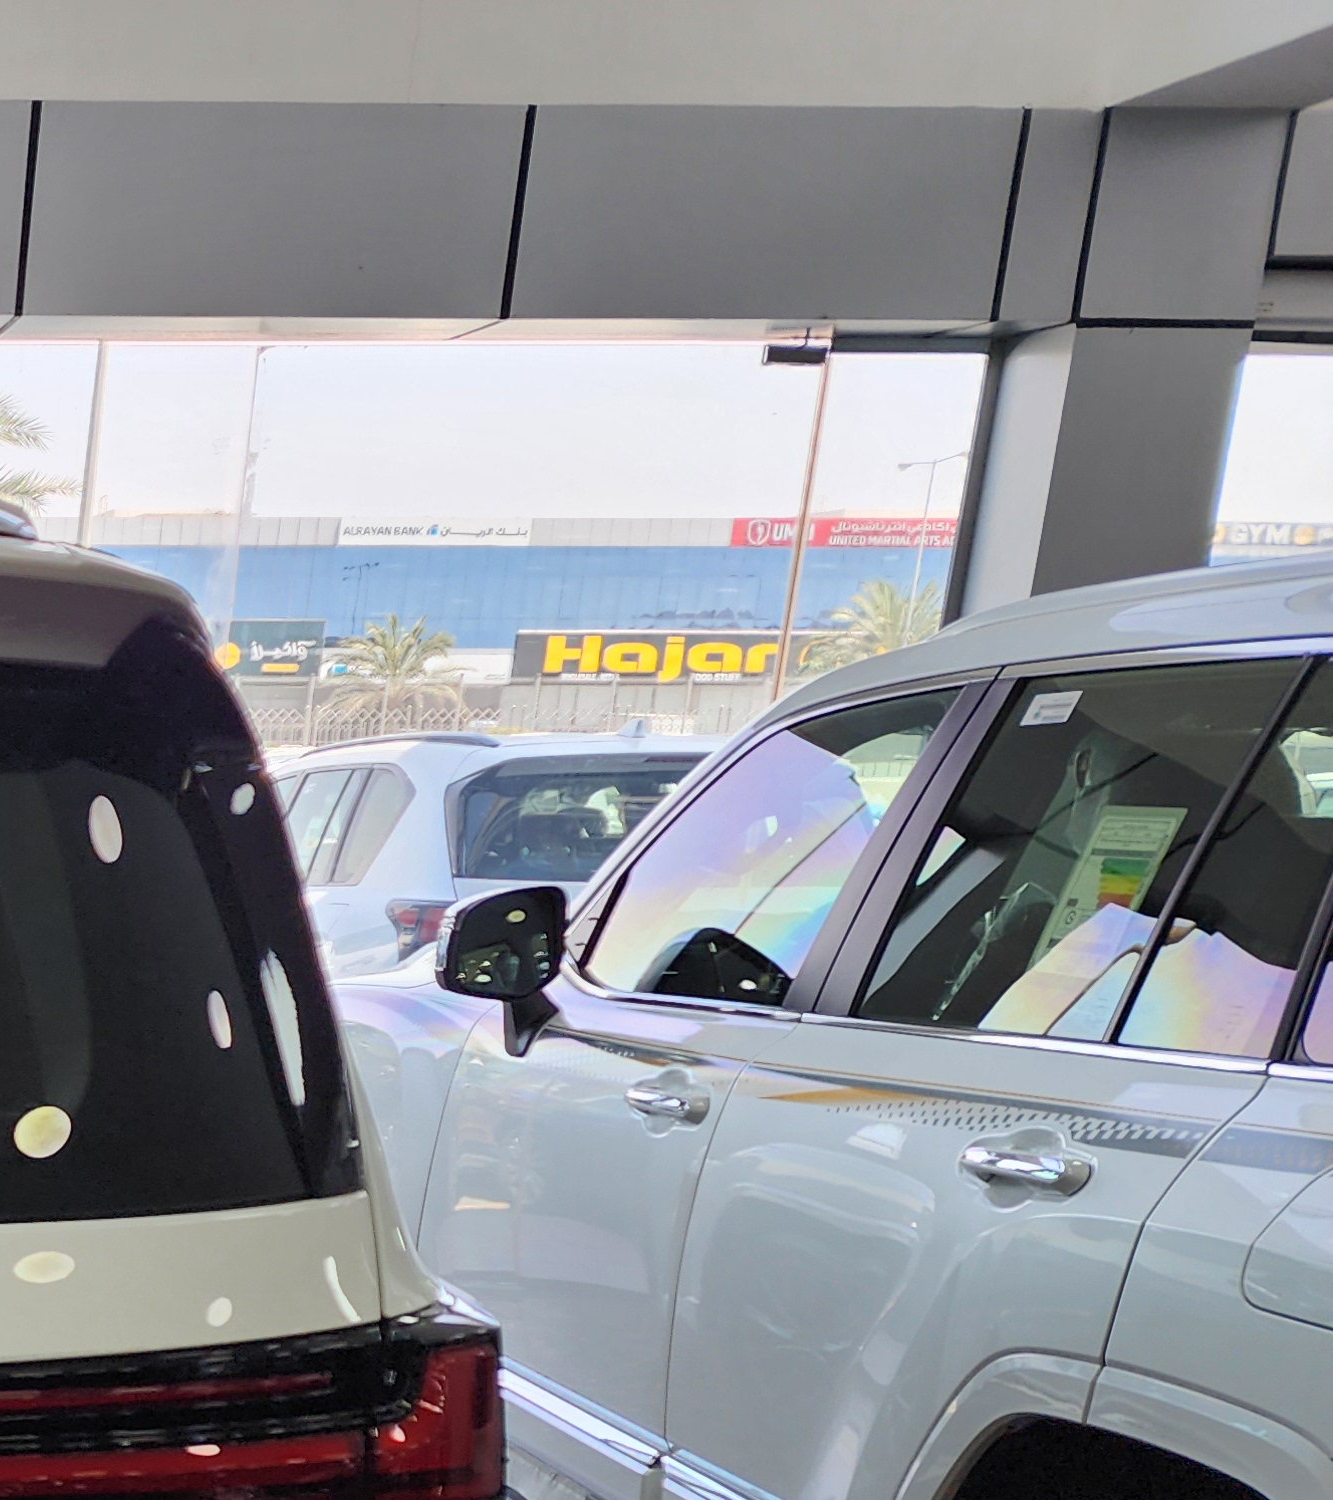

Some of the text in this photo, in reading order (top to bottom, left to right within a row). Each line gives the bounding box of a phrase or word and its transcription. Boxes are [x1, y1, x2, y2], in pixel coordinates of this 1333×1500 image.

[343, 525, 424, 537] ALRAYAN BANK
[773, 523, 816, 541] UMI
[1230, 523, 1292, 545] GYM
[829, 535, 866, 546] UNITED
[868, 535, 911, 546] MARTIAL
[914, 535, 941, 546] ARTS
[542, 635, 780, 684] Hajar
